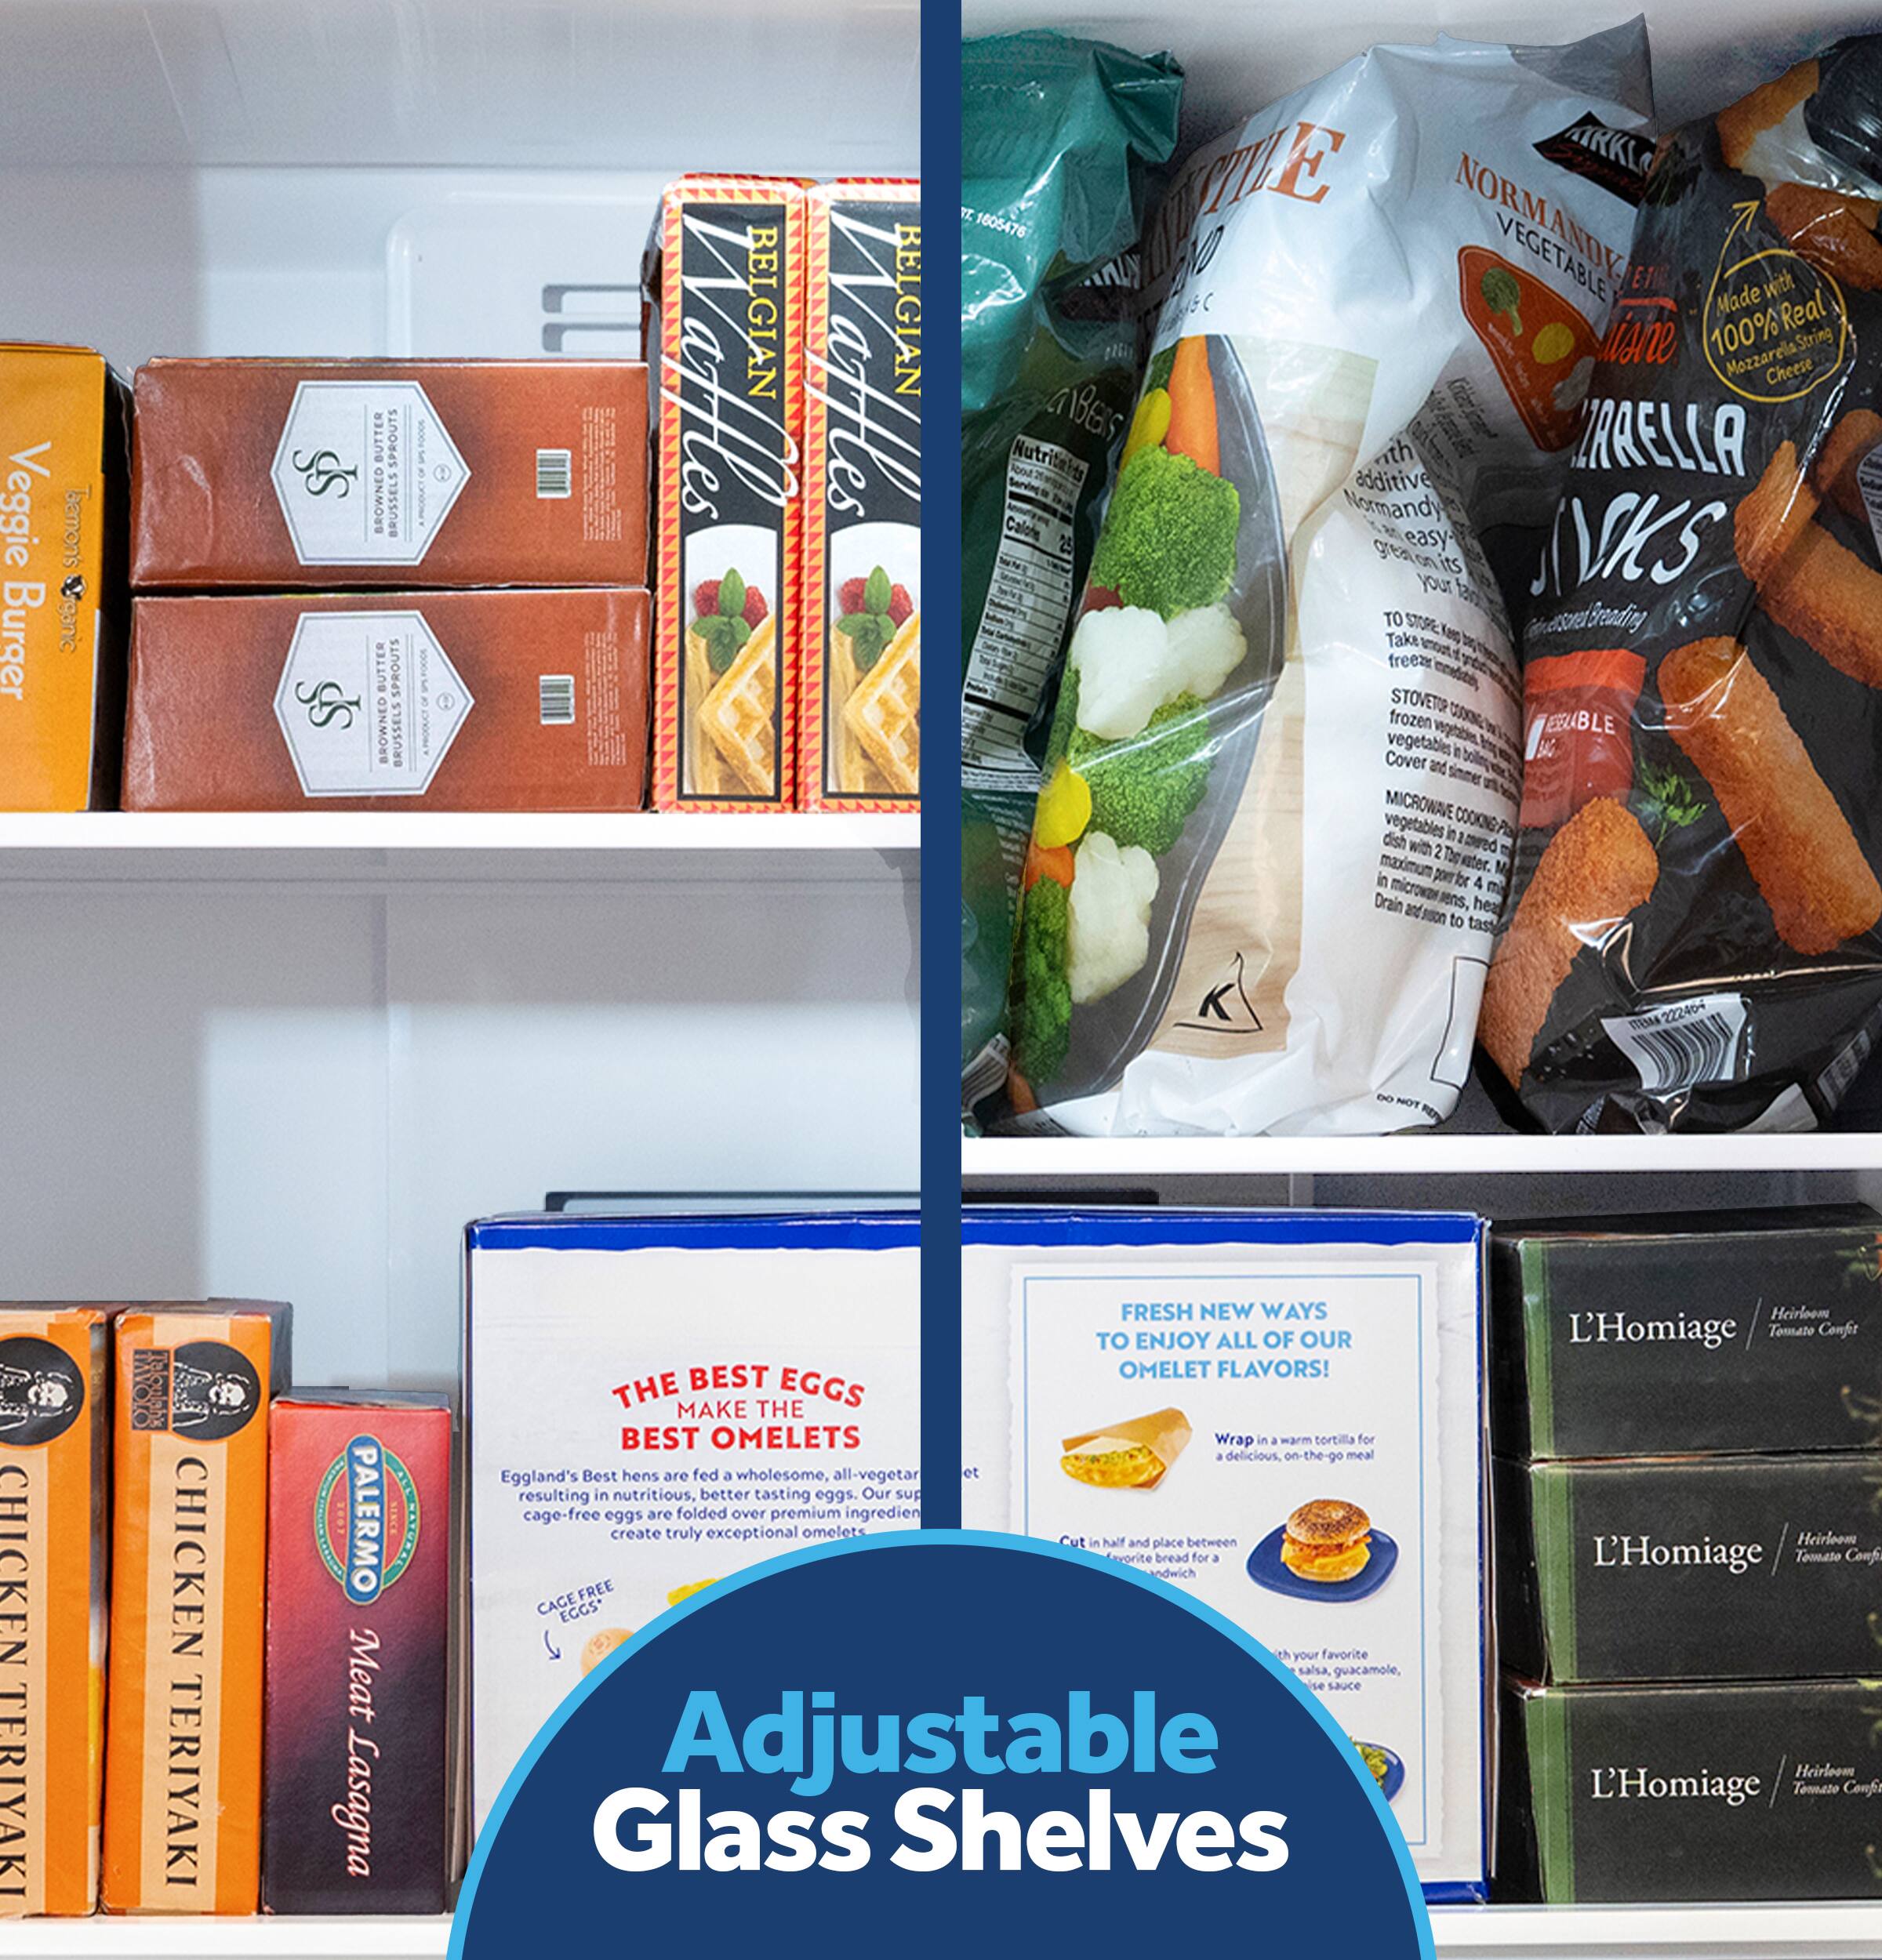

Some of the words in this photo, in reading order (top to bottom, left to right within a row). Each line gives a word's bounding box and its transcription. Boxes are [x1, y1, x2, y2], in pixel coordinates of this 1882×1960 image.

[1497, 212, 1607, 303] VEGETABLE
[1717, 284, 1761, 317] Made
[1764, 268, 1795, 299] with
[747, 225, 778, 400] BELGIAN
[894, 223, 921, 397] BELGIAN
[1711, 307, 1779, 356] 100%
[1781, 289, 1826, 331] Real
[660, 213, 798, 520] Waffles
[1727, 340, 1797, 377] Mozzarella
[1796, 328, 1834, 350] String
[1767, 358, 1813, 385] Cheese
[373, 412, 385, 463] BUTTER
[387, 408, 399, 468] SPROUTS
[1571, 397, 1747, 477] ZARELLA
[0, 441, 52, 568] Veggie
[373, 466, 385, 534] BROWNED
[387, 472, 399, 539] BRUSSELS
[418, 481, 427, 520] PRODUCT
[1438, 554, 1463, 575] its
[1417, 573, 1453, 594] your
[1383, 611, 1404, 627] TO
[0, 582, 46, 701] Burger
[1386, 632, 1419, 648] Take
[375, 641, 387, 692] BUTTER
[389, 638, 401, 698] SPROUTS
[377, 697, 389, 764] BROWNED
[391, 702, 403, 768] BRUSSELS
[1390, 709, 1433, 730] frozen
[1385, 750, 1427, 771] Cover
[1385, 789, 1454, 820] MICROWAVE
[1385, 812, 1445, 839] vegetables
[1382, 831, 1407, 849] dish
[1408, 837, 1433, 857] with
[1376, 871, 1389, 888] in
[1380, 853, 1433, 878] maximum
[1473, 876, 1483, 891] 4
[1374, 892, 1404, 915] Drain
[1449, 912, 1465, 930] to
[1197, 982, 1236, 1022] K
[1376, 1092, 1394, 1104] DO
[1396, 1096, 1421, 1111] NOT
[1121, 1303, 1194, 1322] FRESH
[1201, 1302, 1255, 1321] NEW
[1260, 1301, 1328, 1320] WAYS
[1770, 1305, 1830, 1320] Heirloom
[1095, 1331, 1130, 1350] TO
[1136, 1331, 1211, 1350] ENJOY
[1216, 1330, 1258, 1349] ALL
[1263, 1330, 1295, 1349] OF
[1299, 1330, 1352, 1349] OUR
[1569, 1311, 1738, 1351] L'Homiage
[1768, 1323, 1815, 1338] Tomato
[1818, 1319, 1858, 1340] Confit
[1119, 1360, 1212, 1380] OMELET
[1217, 1359, 1329, 1379] FLAVORS!
[612, 1372, 679, 1410] THE
[689, 1364, 769, 1392] BEST
[780, 1367, 865, 1408] EGGS
[677, 1400, 747, 1419] MAKE
[756, 1399, 805, 1418] THE
[622, 1426, 699, 1450] BEST
[710, 1425, 861, 1450] OMELETS
[1215, 1432, 1255, 1448] Wrap
[1257, 1434, 1268, 1446] in
[1280, 1436, 1313, 1446] warm
[1314, 1433, 1356, 1446] tortilla
[1357, 1433, 1375, 1445] for
[1225, 1450, 1282, 1463] delicious,
[1284, 1450, 1344, 1465] on-the-go
[1346, 1449, 1375, 1461] meal
[396, 1470, 412, 1496] ALL
[500, 1469, 579, 1487] Eggland's
[582, 1469, 618, 1483] Best
[622, 1468, 659, 1483] hens
[663, 1471, 689, 1483] are
[692, 1468, 719, 1483] fed
[736, 1468, 829, 1483] wholesome,
[833, 1467, 921, 1485] all-vegetar
[518, 1488, 590, 1506] resulting
[594, 1488, 609, 1502] in
[612, 1487, 696, 1504] nutritious,
[699, 1486, 750, 1502] better
[754, 1486, 812, 1504] tasting
[815, 1490, 859, 1504] eggs.
[862, 1486, 892, 1501] Our
[351, 1446, 381, 1593] PALERMO
[523, 1506, 601, 1526] cage-free
[605, 1510, 644, 1525] eggs
[647, 1509, 673, 1521] are
[676, 1505, 728, 1521] folded
[732, 1508, 767, 1520] over
[770, 1505, 842, 1523] premium
[845, 1505, 921, 1523] ingredien
[395, 1502, 417, 1567] NATURAL
[610, 1528, 662, 1541] create
[666, 1526, 703, 1543] truly
[706, 1525, 798, 1543] exceptional
[1059, 1534, 1085, 1548] Cut
[1088, 1537, 1100, 1548] in
[1103, 1536, 1126, 1548] half
[1128, 1537, 1150, 1548] and
[1153, 1536, 1184, 1550] place
[1186, 1536, 1237, 1548] between
[1797, 1530, 1857, 1545] Heirloom
[0, 1465, 29, 1667] CHICKEN
[172, 1457, 208, 1657] CHICKEN
[1155, 1552, 1189, 1564] bread
[1191, 1552, 1209, 1563] for
[1593, 1534, 1764, 1574] L'Homiage
[1795, 1548, 1842, 1563] Tomato
[1845, 1545, 1882, 1566] Confi
[1150, 1567, 1197, 1579] andwich
[537, 1592, 576, 1615] CAGE
[578, 1579, 614, 1601] FREE
[1293, 1650, 1320, 1663] your
[1321, 1648, 1369, 1661] favorite
[349, 1628, 380, 1725] Meat
[1299, 1664, 1332, 1678] salsa,
[1333, 1664, 1402, 1679] guacamole,
[1328, 1681, 1363, 1692] sauce
[165, 1674, 203, 1888] TERIYAKI
[1795, 1762, 1855, 1778] Heirloom
[0, 1682, 28, 1898] TERIYAKI
[1590, 1766, 1761, 1806] L'Homiage
[1793, 1780, 1840, 1795] Tomato
[330, 1726, 380, 1878] Lasagna
